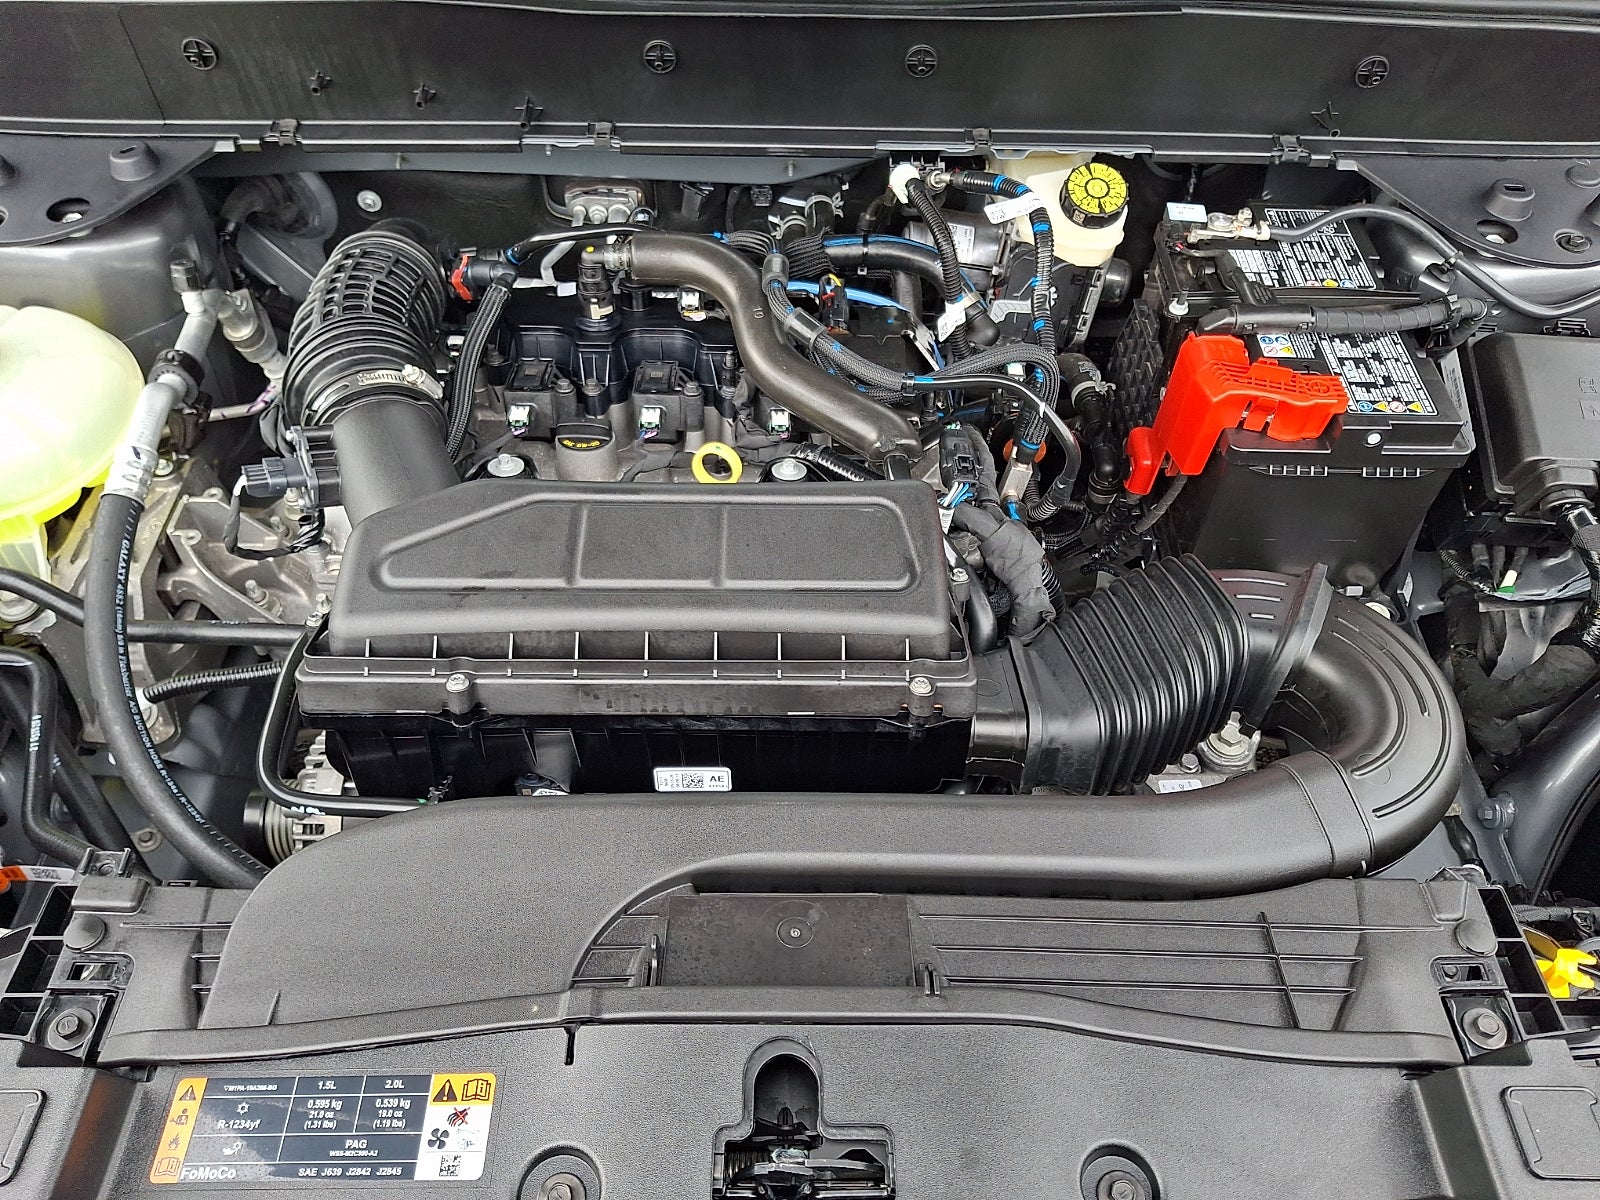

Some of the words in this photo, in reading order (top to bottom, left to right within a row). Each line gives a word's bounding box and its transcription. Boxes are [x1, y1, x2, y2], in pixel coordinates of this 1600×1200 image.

[117, 539, 130, 584] GALAXY
[133, 714, 153, 749] SUCTION
[709, 775, 725, 783] AE
[317, 1080, 337, 1090] 1.5L
[384, 1079, 405, 1089] 2.0L
[307, 1099, 331, 1109] 0.595
[331, 1099, 343, 1111] kg
[375, 1098, 399, 1108] 0.539
[399, 1098, 412, 1110] kg
[324, 1111, 335, 1119] oz
[378, 1110, 394, 1118] 19.0
[393, 1110, 404, 1118] oz
[217, 1119, 261, 1131] R-1234yf
[345, 1139, 368, 1149] PAG
[180, 1167, 237, 1180] FoMoCo
[298, 1168, 318, 1177] SAE
[320, 1167, 343, 1177] J639
[345, 1167, 372, 1177] J2842
[375, 1166, 402, 1176] J2845
